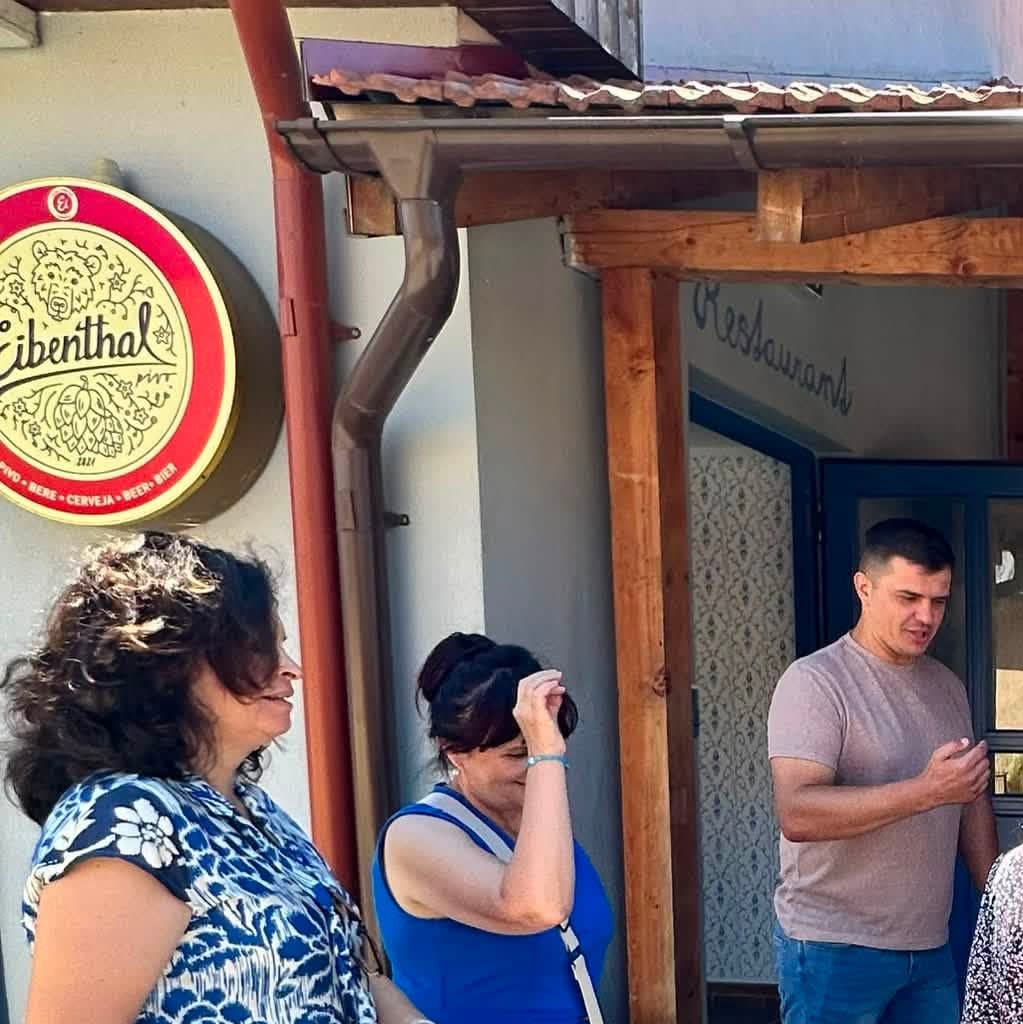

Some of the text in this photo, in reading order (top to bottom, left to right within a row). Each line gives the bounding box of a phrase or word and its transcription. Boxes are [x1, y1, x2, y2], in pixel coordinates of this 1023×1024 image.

[694, 282, 854, 417] Restaurant
[28, 480, 57, 502] BERE
[67, 494, 115, 507] CERVEJA
[122, 484, 150, 502] BEER
[154, 462, 178, 486] BIER
